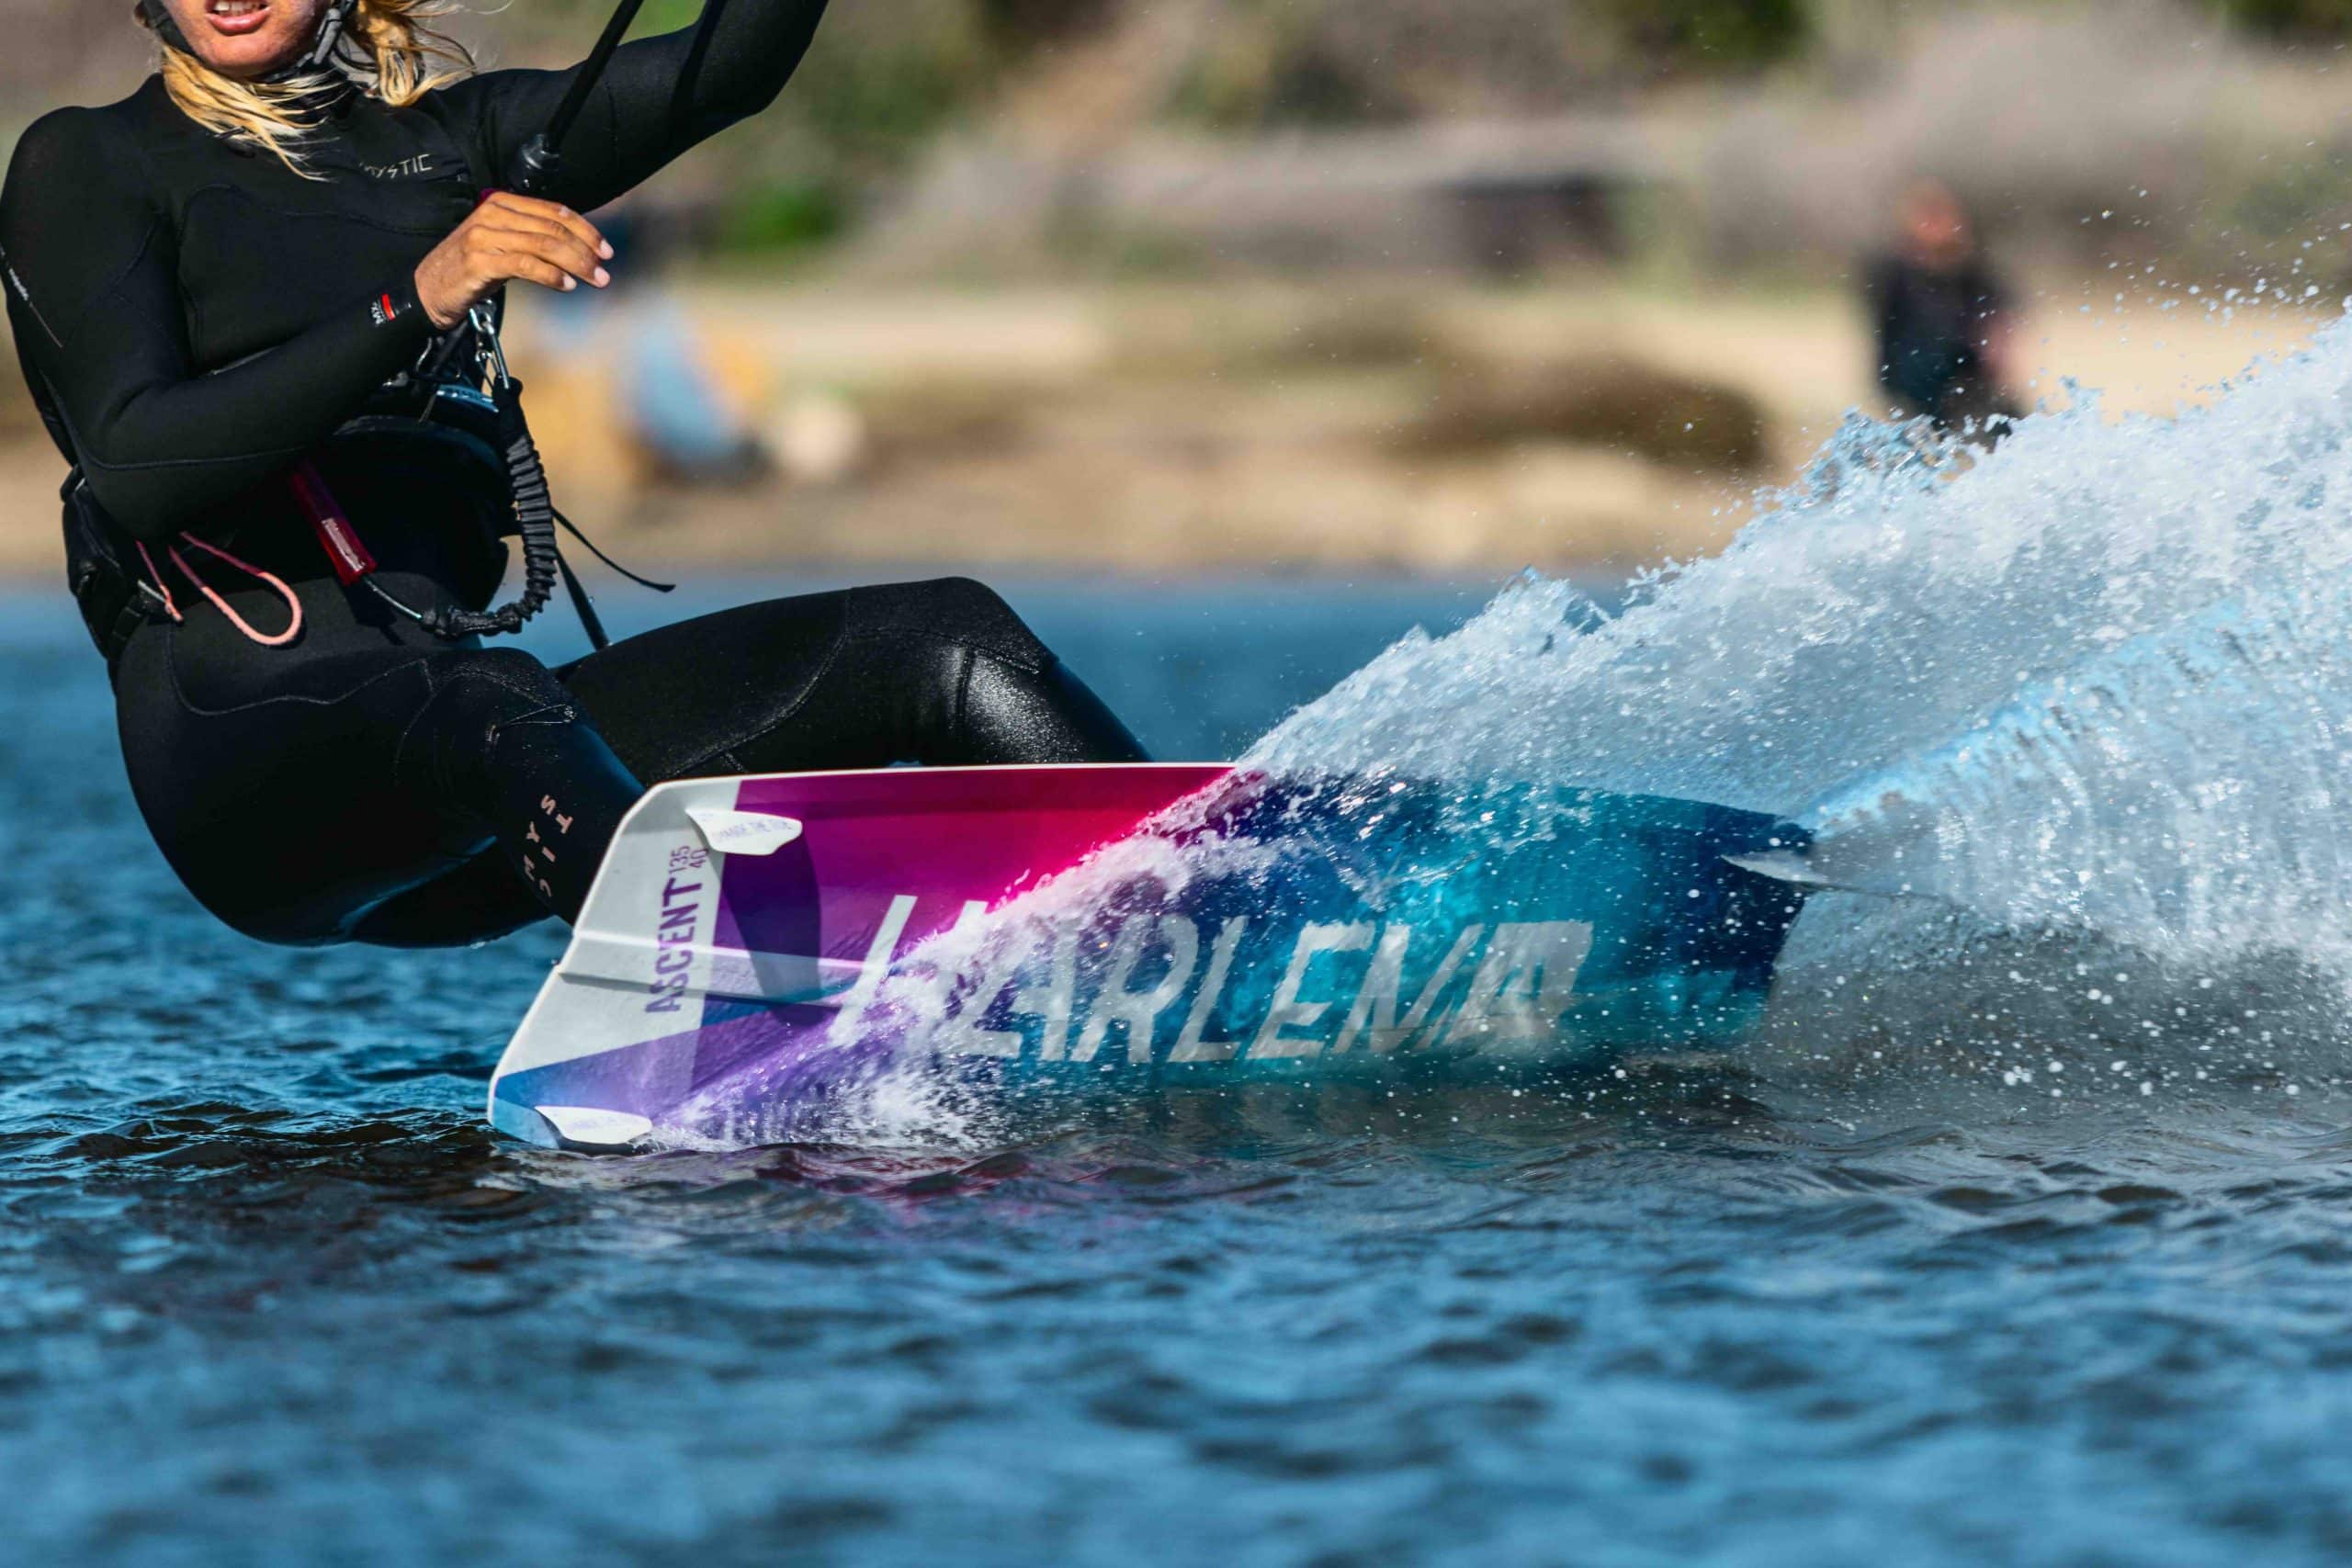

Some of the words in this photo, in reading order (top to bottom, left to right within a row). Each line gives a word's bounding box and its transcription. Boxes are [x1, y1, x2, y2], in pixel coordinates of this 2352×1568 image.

[669, 844, 691, 874] 135
[689, 848, 709, 869] 40
[645, 877, 703, 1013] ASCENT
